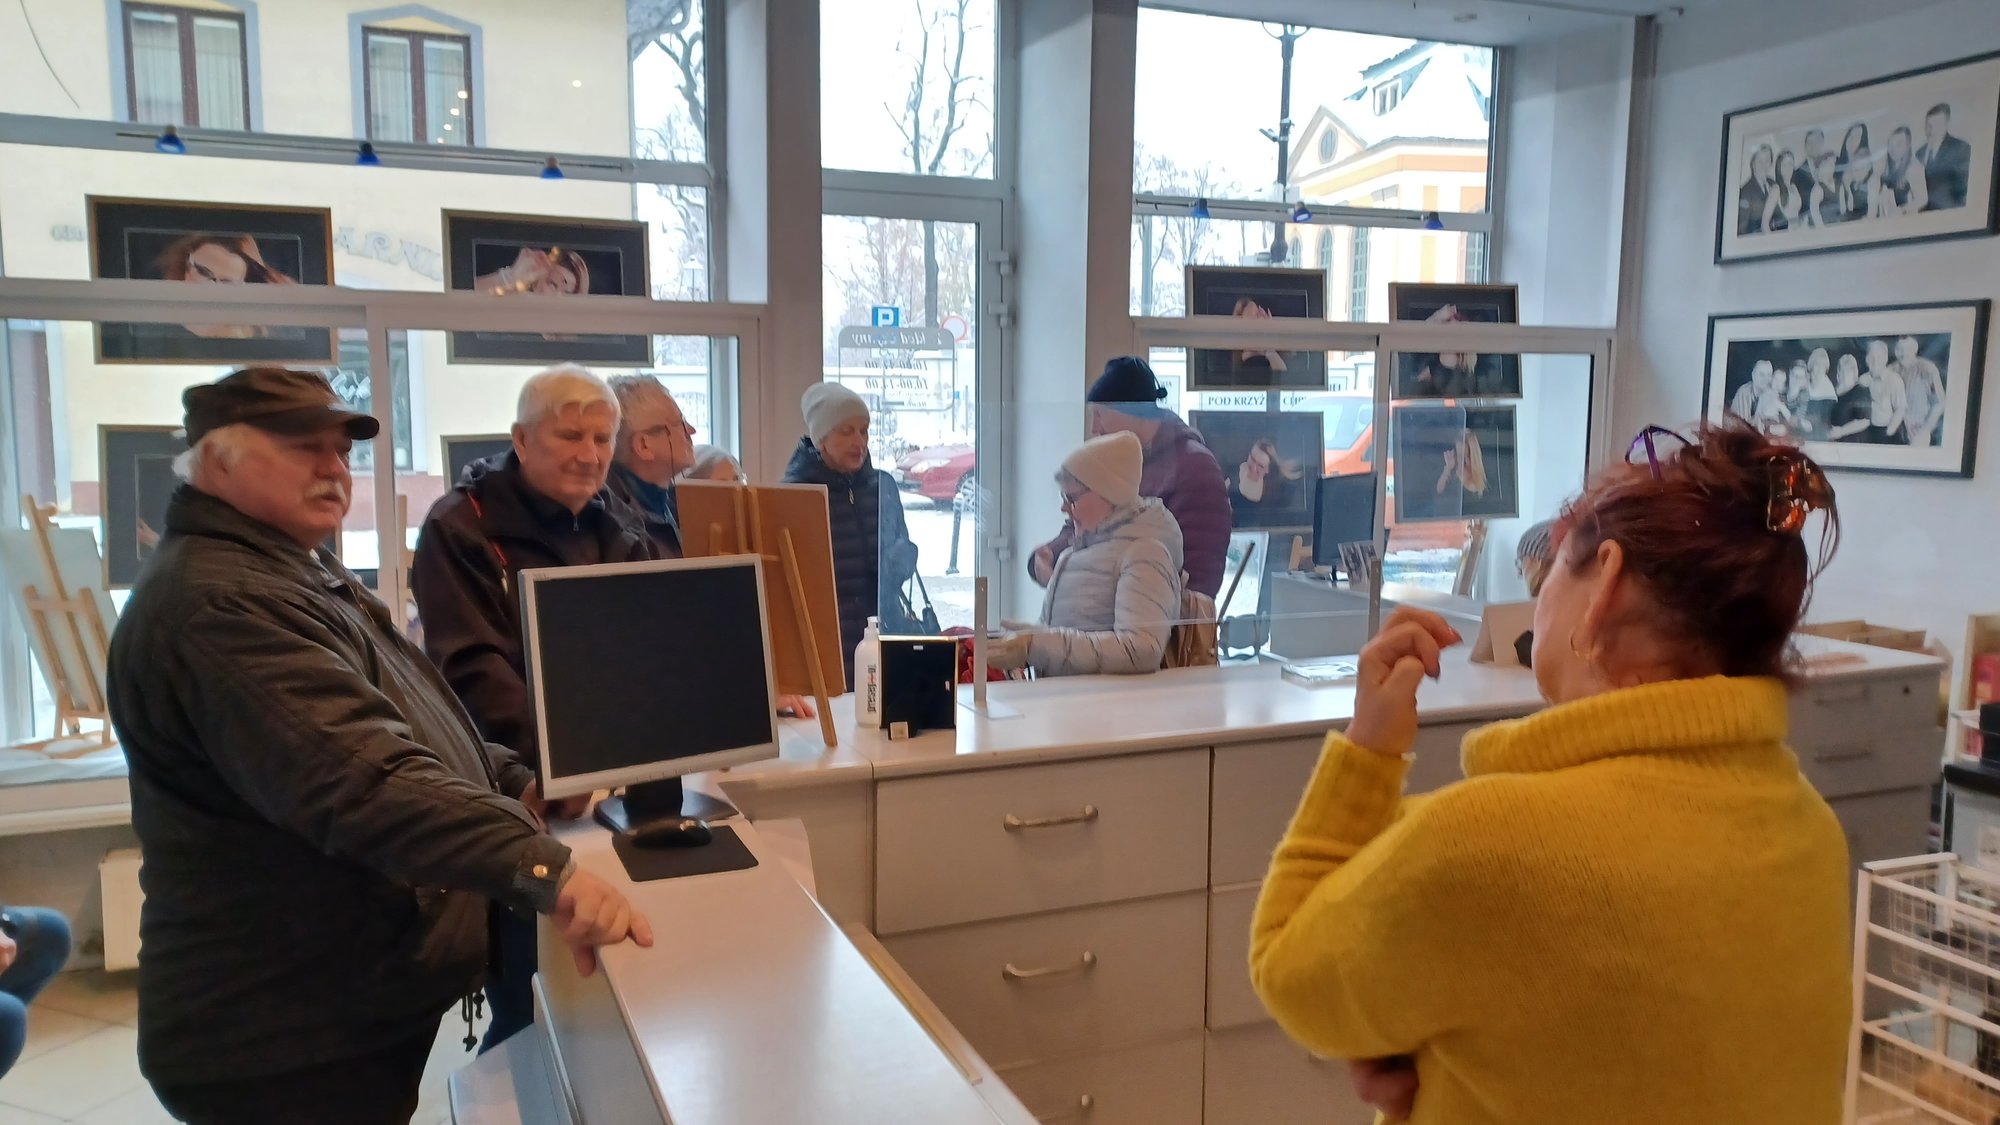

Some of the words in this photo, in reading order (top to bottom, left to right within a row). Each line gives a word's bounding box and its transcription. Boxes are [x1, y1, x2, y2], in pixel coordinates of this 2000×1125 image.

[877, 308, 894, 328] P
[1208, 396, 1231, 406] POD
[1234, 393, 1265, 406] KRZYŻ
